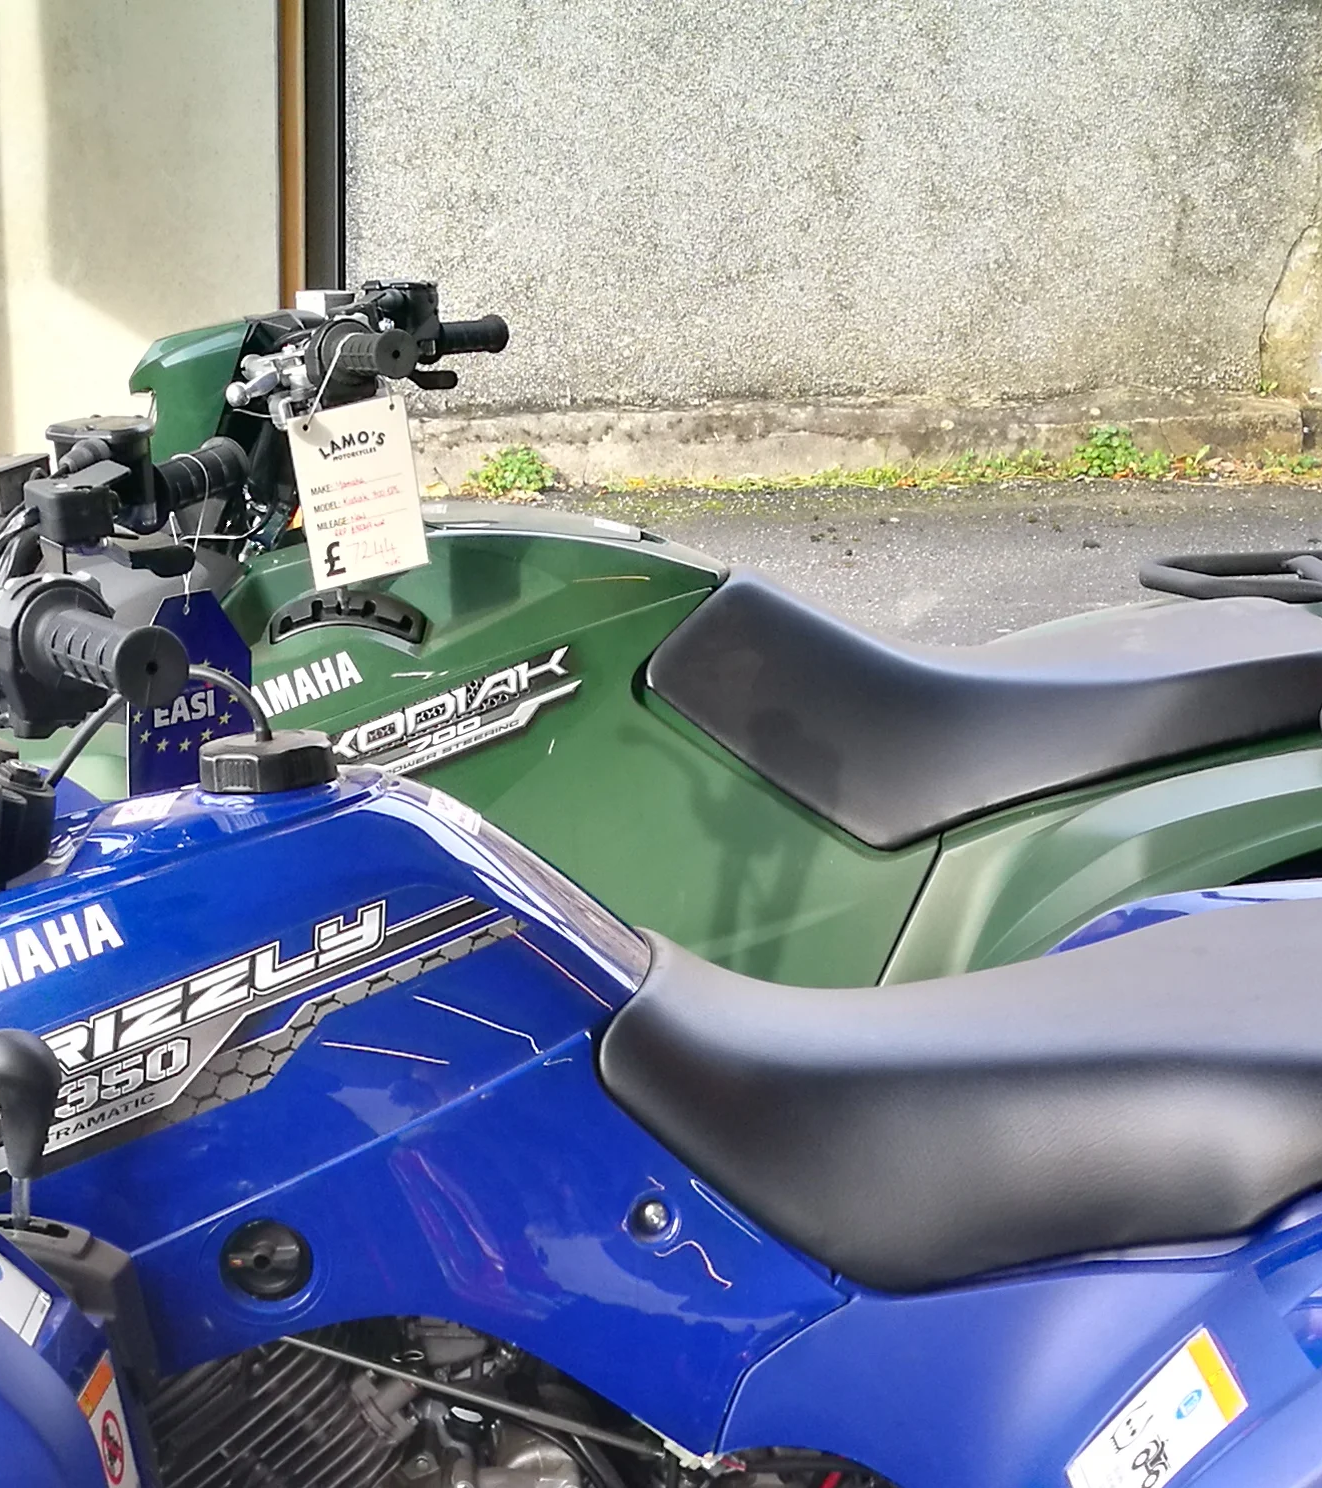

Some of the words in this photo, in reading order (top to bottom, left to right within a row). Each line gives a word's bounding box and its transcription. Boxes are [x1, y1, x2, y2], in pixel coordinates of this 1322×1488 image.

[318, 430, 386, 460] LAMO'S
[332, 447, 376, 461] MOTORCYCLES
[251, 650, 364, 723] AMAHA
[332, 645, 570, 760] KODIAK
[407, 715, 482, 753] 700
[441, 718, 521, 755] STEERING
[54, 1036, 192, 1120] 350
[49, 1091, 157, 1140] RAMATIC
